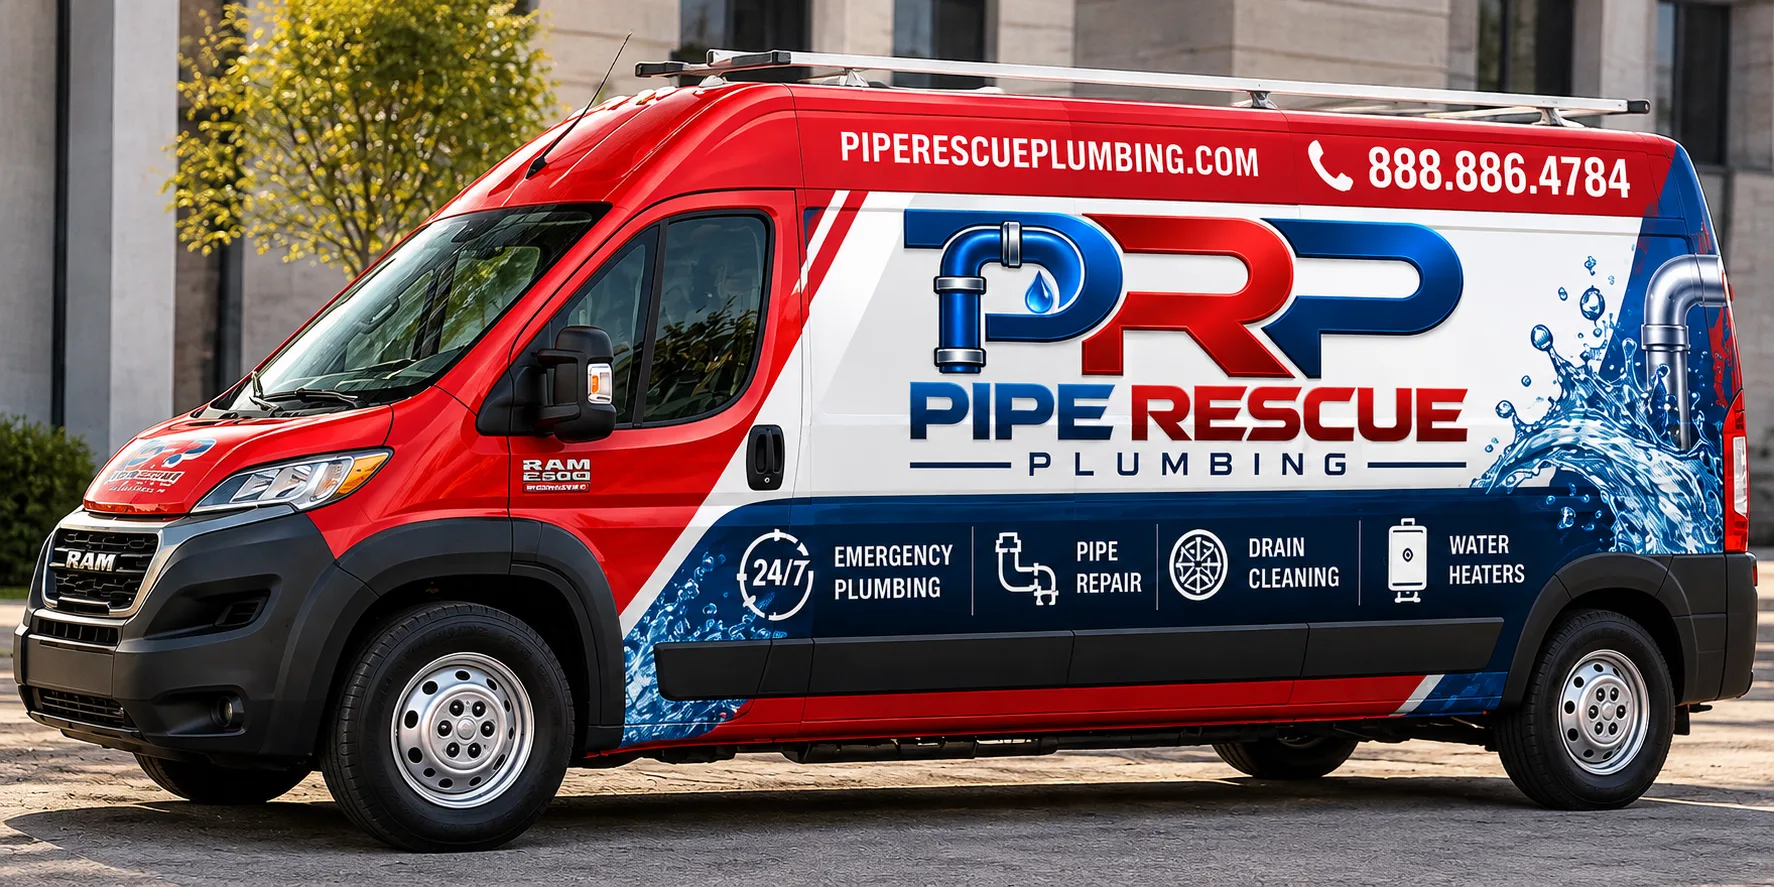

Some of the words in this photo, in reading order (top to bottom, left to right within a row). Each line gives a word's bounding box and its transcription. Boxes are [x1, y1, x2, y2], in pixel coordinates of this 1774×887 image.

[840, 131, 1260, 177] PIPERESCUEPLUMBING.COM
[1368, 146, 1631, 198] 888.886.4784
[903, 208, 1465, 380] PRP
[909, 382, 1116, 441] PIPE
[1131, 385, 1469, 442] RESCUE
[523, 459, 591, 471] RAM
[1028, 452, 1347, 476] PLUMBING
[834, 544, 954, 568] EMERGENCY
[1076, 541, 1119, 562] PIPE
[1248, 537, 1305, 558] DRAIN
[1449, 534, 1510, 555] WATER
[65, 550, 117, 572] RAM
[752, 558, 811, 587] 24/7
[1076, 572, 1142, 594] REPAIR
[1248, 566, 1340, 589] CLEANING
[1449, 563, 1526, 585] HEATERS
[834, 576, 941, 600] PLUMBING
